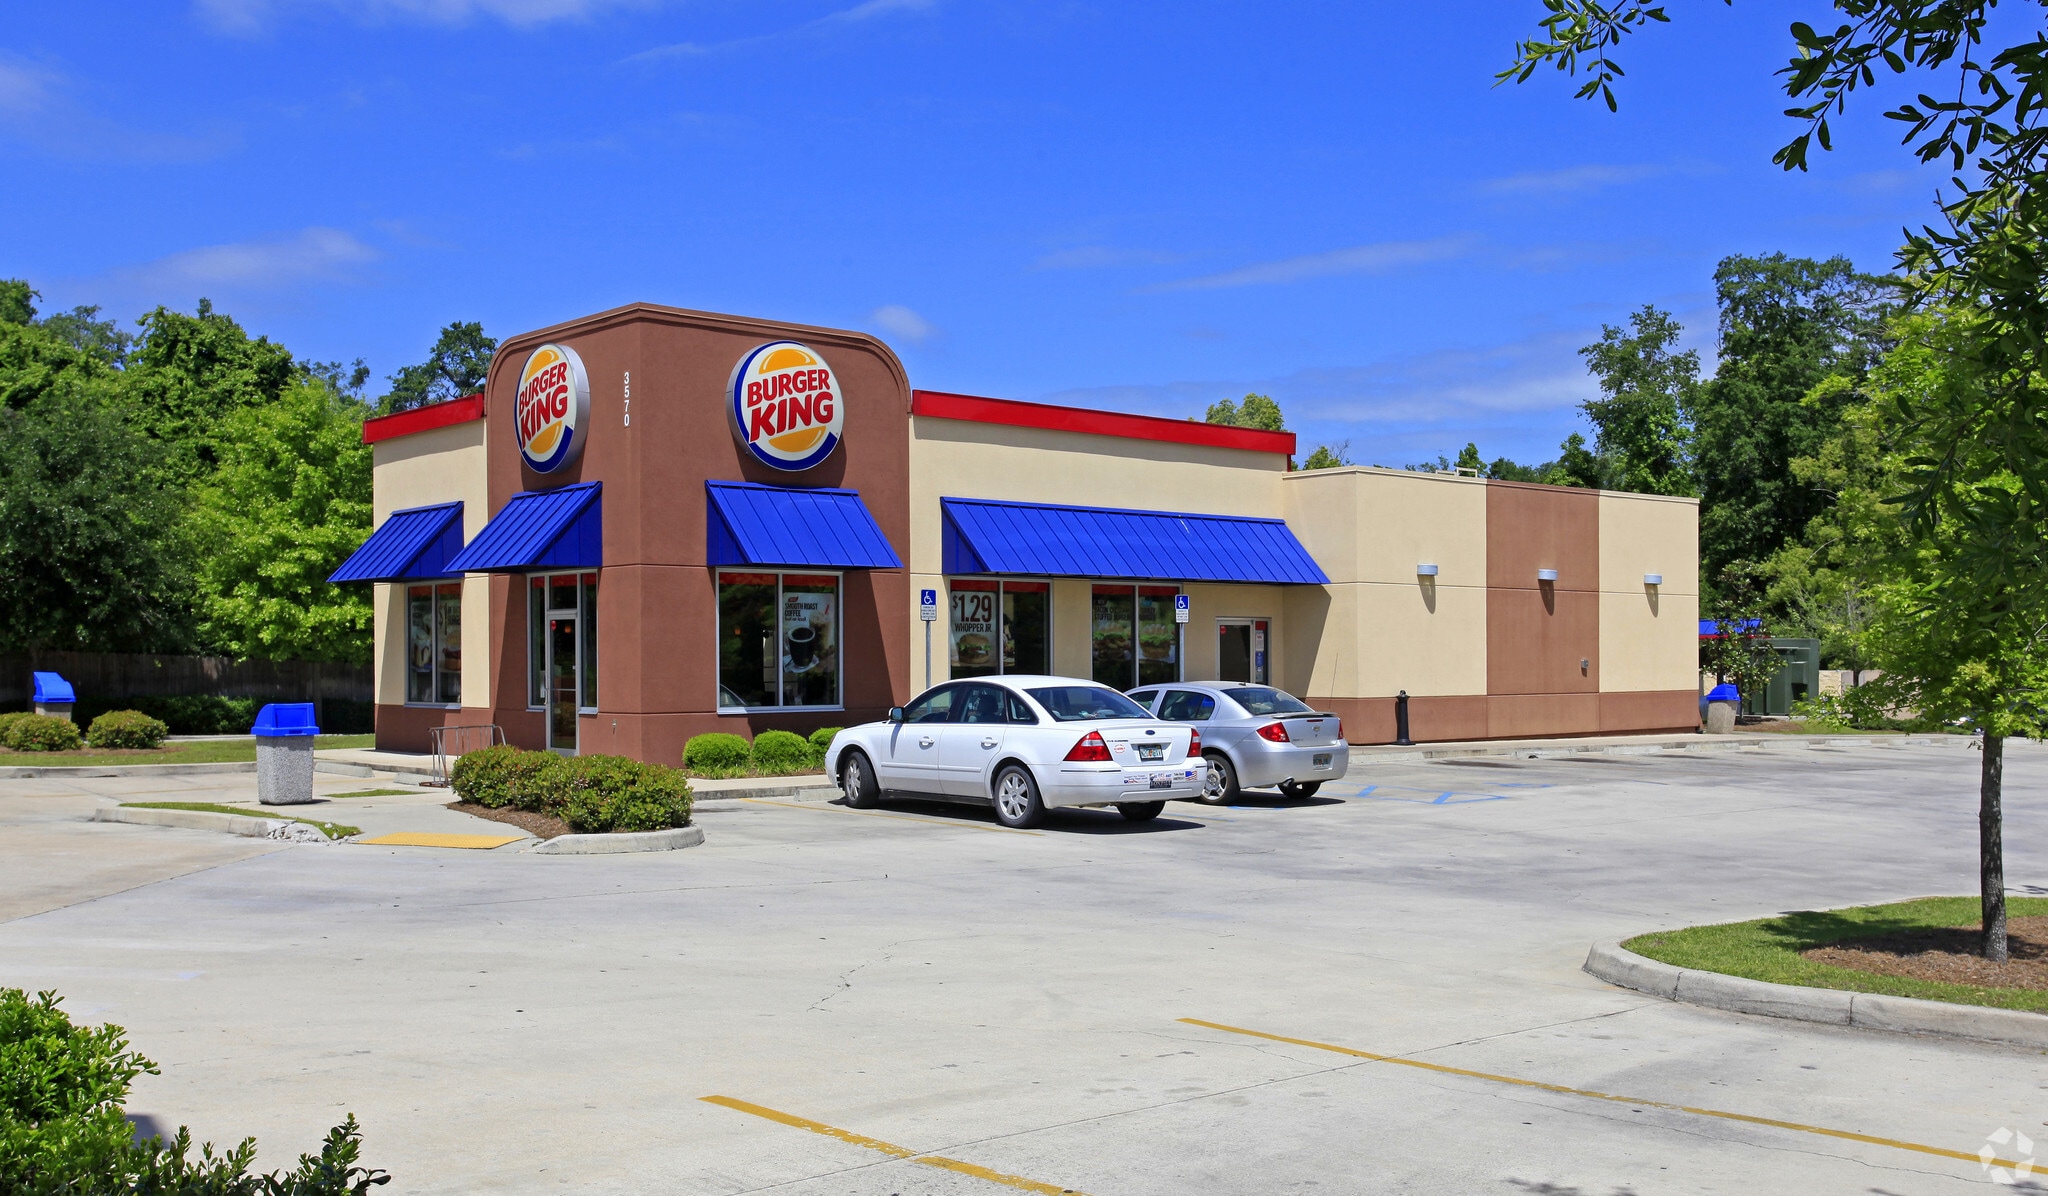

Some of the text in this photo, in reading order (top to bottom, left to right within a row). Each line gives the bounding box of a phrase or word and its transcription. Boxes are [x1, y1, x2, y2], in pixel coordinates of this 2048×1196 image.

[519, 361, 568, 418] BURGER
[747, 369, 831, 408] BURGER
[520, 384, 568, 450] KING
[749, 391, 834, 443] KING
[784, 602, 818, 610] SMOOTH ROAST
[784, 609, 802, 617] COFFEE
[952, 594, 992, 623] $1.29
[954, 623, 984, 633] WHOPPER
